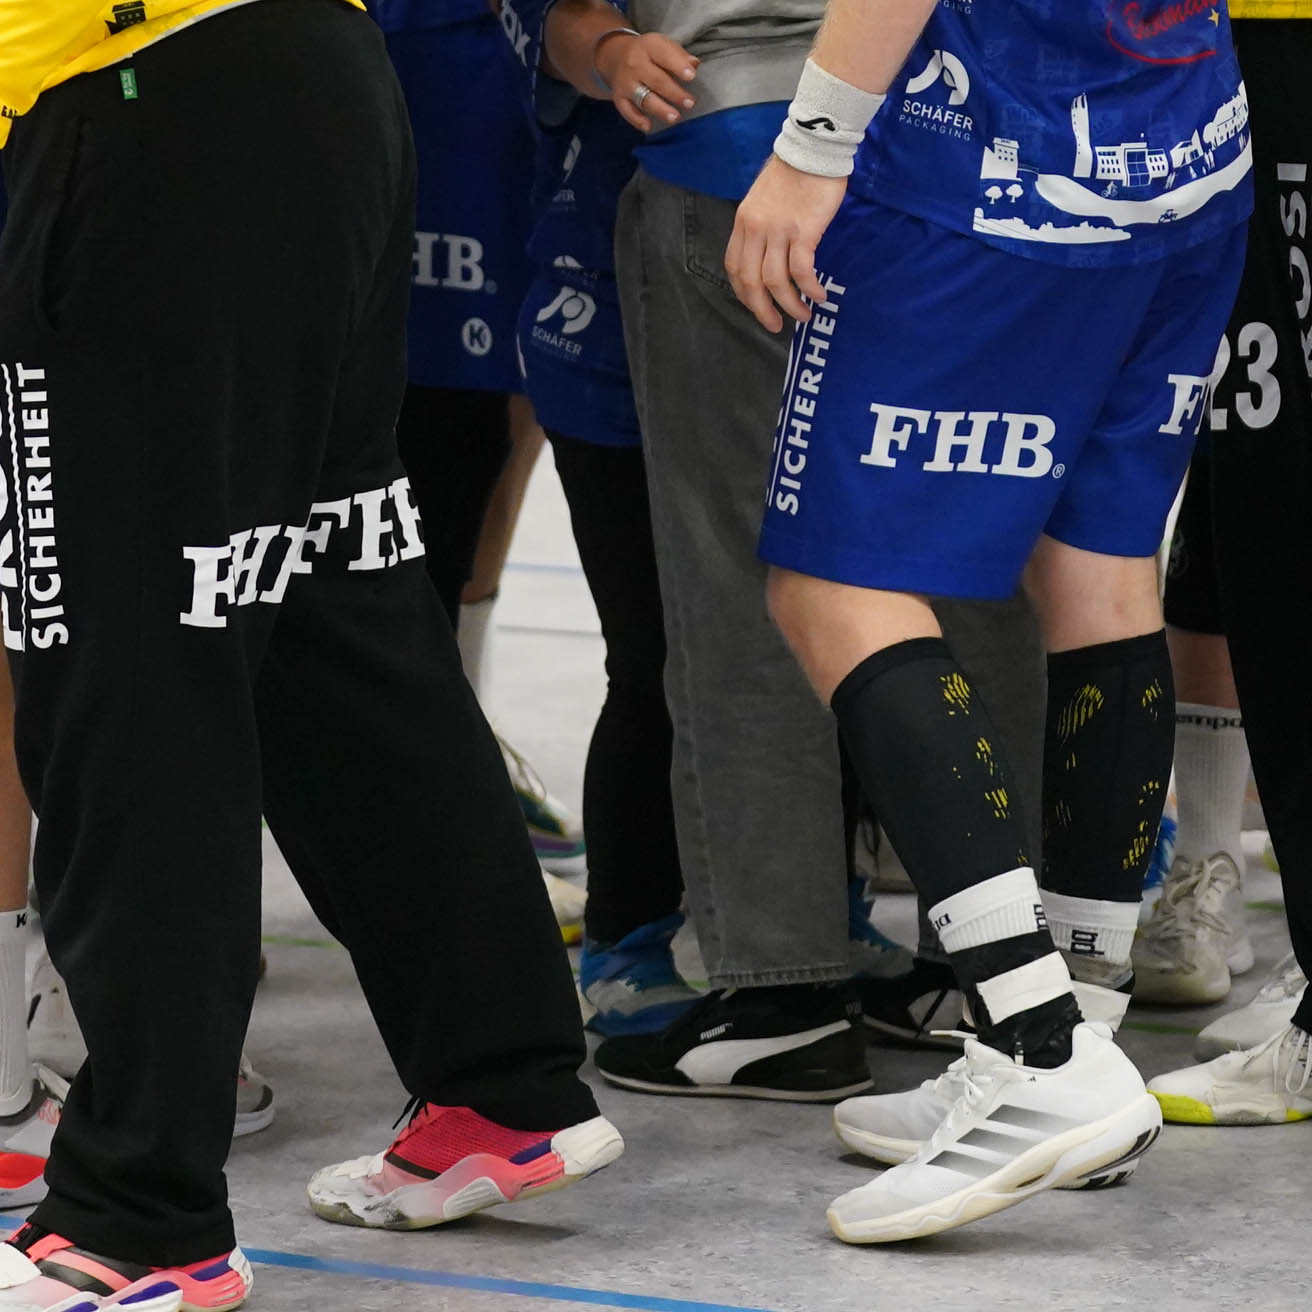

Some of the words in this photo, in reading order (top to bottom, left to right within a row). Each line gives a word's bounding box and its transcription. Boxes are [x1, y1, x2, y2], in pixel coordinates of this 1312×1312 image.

[898, 113, 972, 142] PACKAGING
[902, 97, 974, 132] SCHÄFER
[776, 275, 846, 516] SICHERHEIT
[860, 402, 1056, 479] FHB
[15, 362, 69, 650] SICHERHEIT
